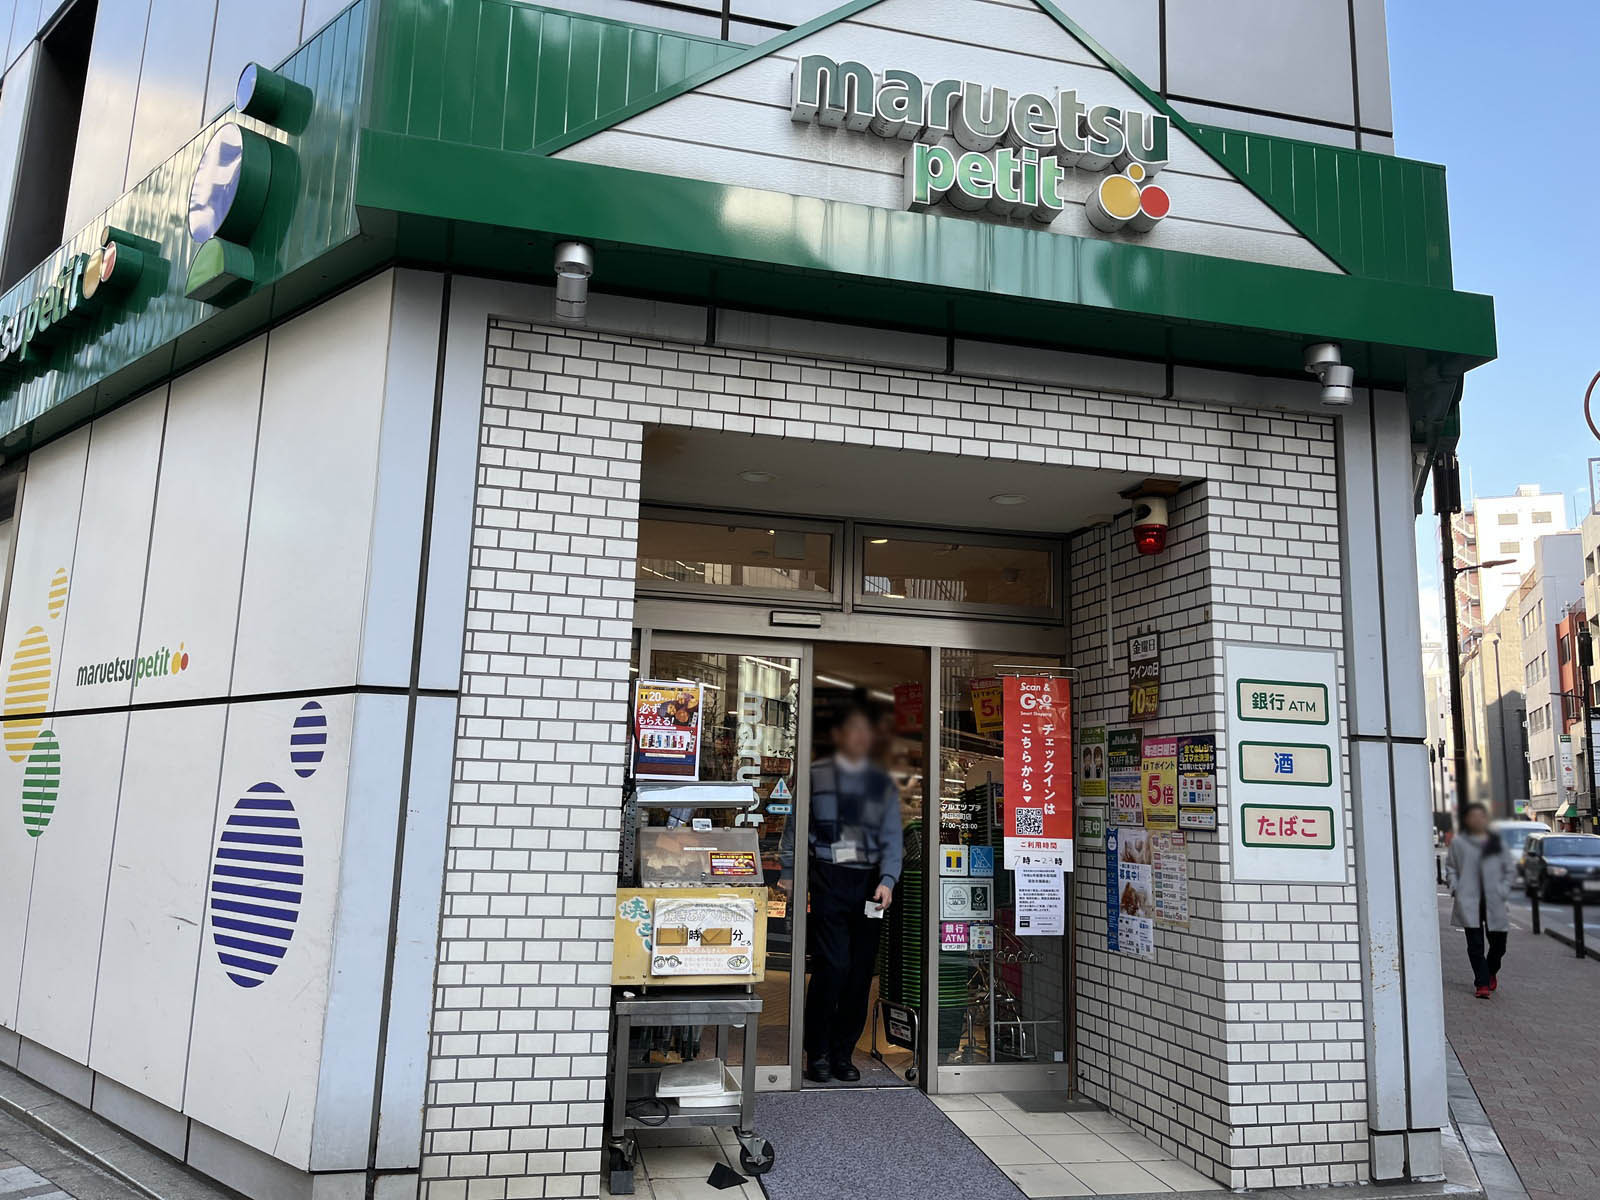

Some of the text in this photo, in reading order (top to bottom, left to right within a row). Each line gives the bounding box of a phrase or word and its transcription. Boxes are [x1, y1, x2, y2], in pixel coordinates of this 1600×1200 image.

[798, 54, 1170, 164] maruetsu
[914, 143, 1065, 210] petit
[19, 253, 84, 362] petit
[1132, 639, 1156, 655] 金曜日
[76, 646, 171, 687] maruetsu petit
[1129, 662, 1159, 679] ワインの日
[1020, 682, 1050, 691] Scan &
[639, 702, 662, 714] 必ず
[1130, 688, 1146, 714] 10
[1251, 691, 1316, 713] 銀行 ATM
[1020, 724, 1033, 792] こちらから
[1042, 723, 1056, 815] チェックインは
[1274, 752, 1294, 774] 酒
[1148, 773, 1174, 806] 5倍
[941, 803, 967, 811] マルエツ
[1257, 815, 1318, 838] たばこ
[1020, 841, 1058, 850] ご利用時間
[945, 923, 964, 933] 銀行
[945, 934, 965, 943] ATM
